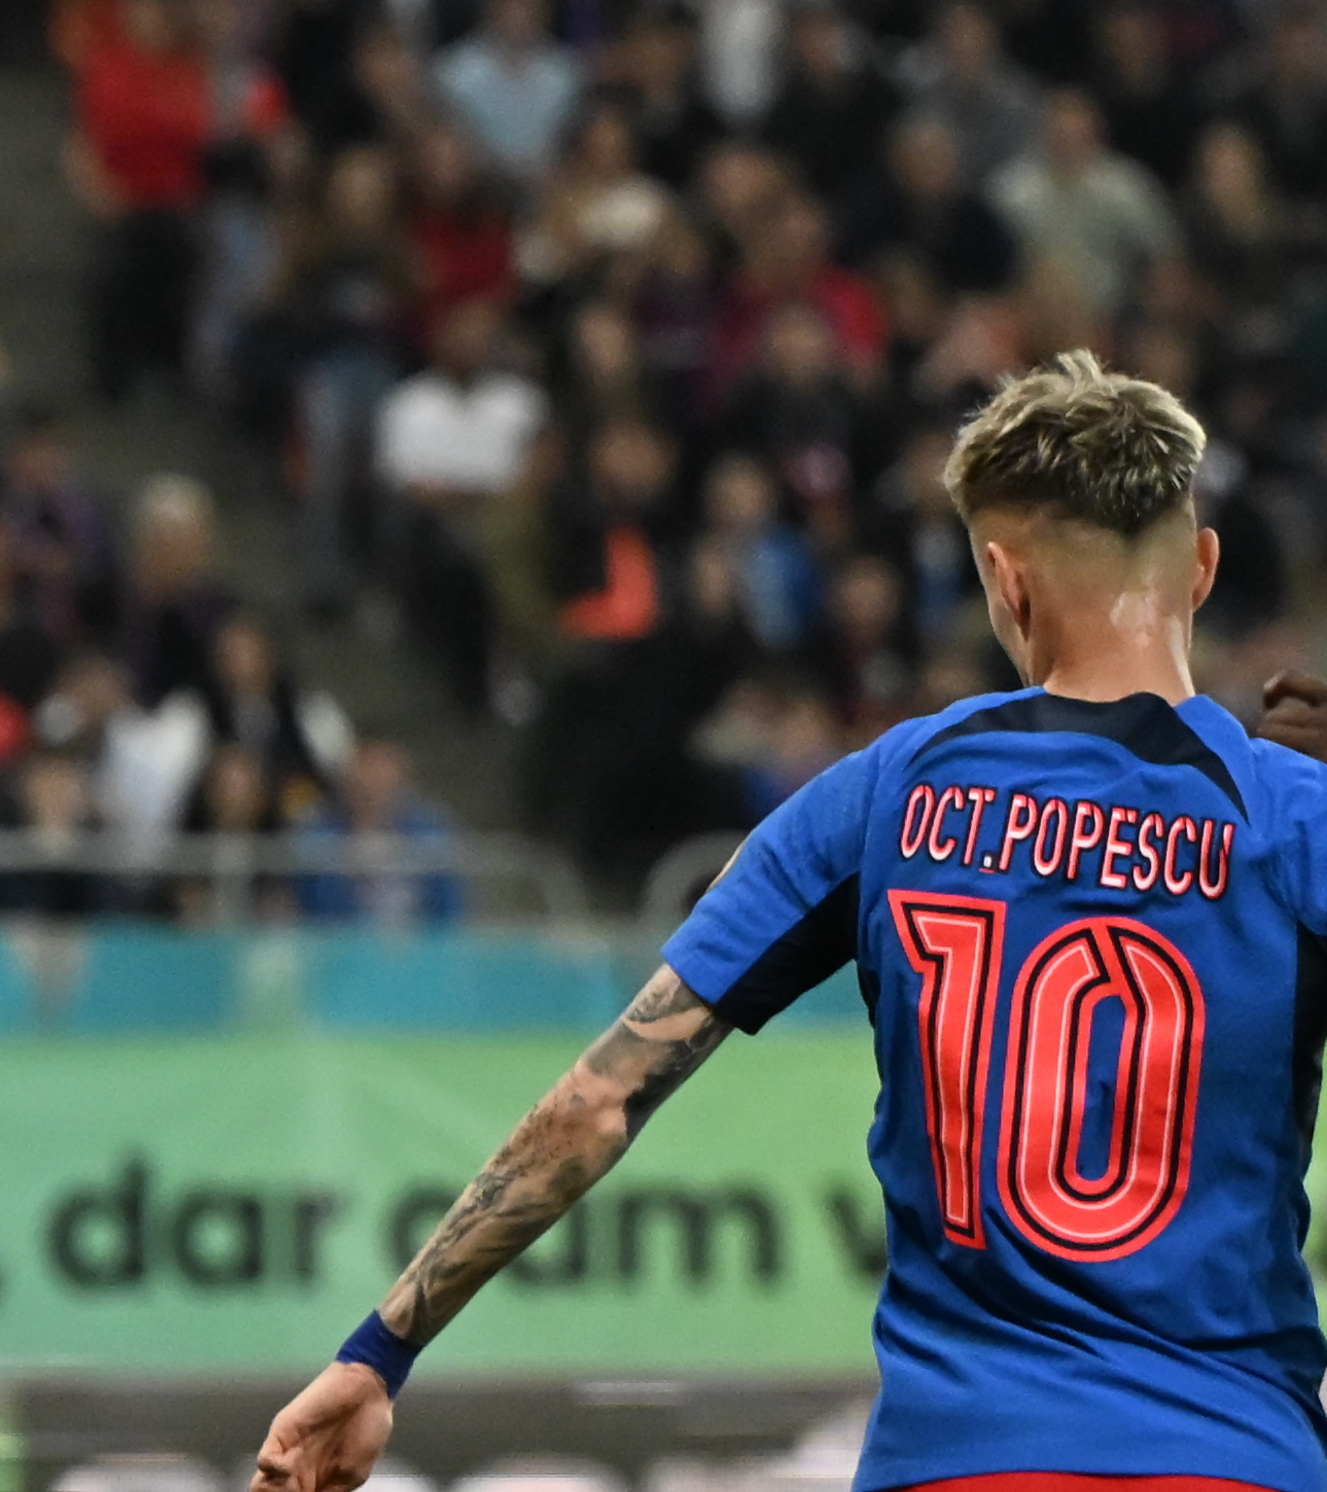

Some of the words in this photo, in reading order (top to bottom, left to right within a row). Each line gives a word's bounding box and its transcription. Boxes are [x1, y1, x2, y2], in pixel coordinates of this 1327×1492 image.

[899, 783, 1236, 900] OCT.POPESCU
[887, 889, 1206, 1262] 10
[44, 1146, 340, 1292] dar
